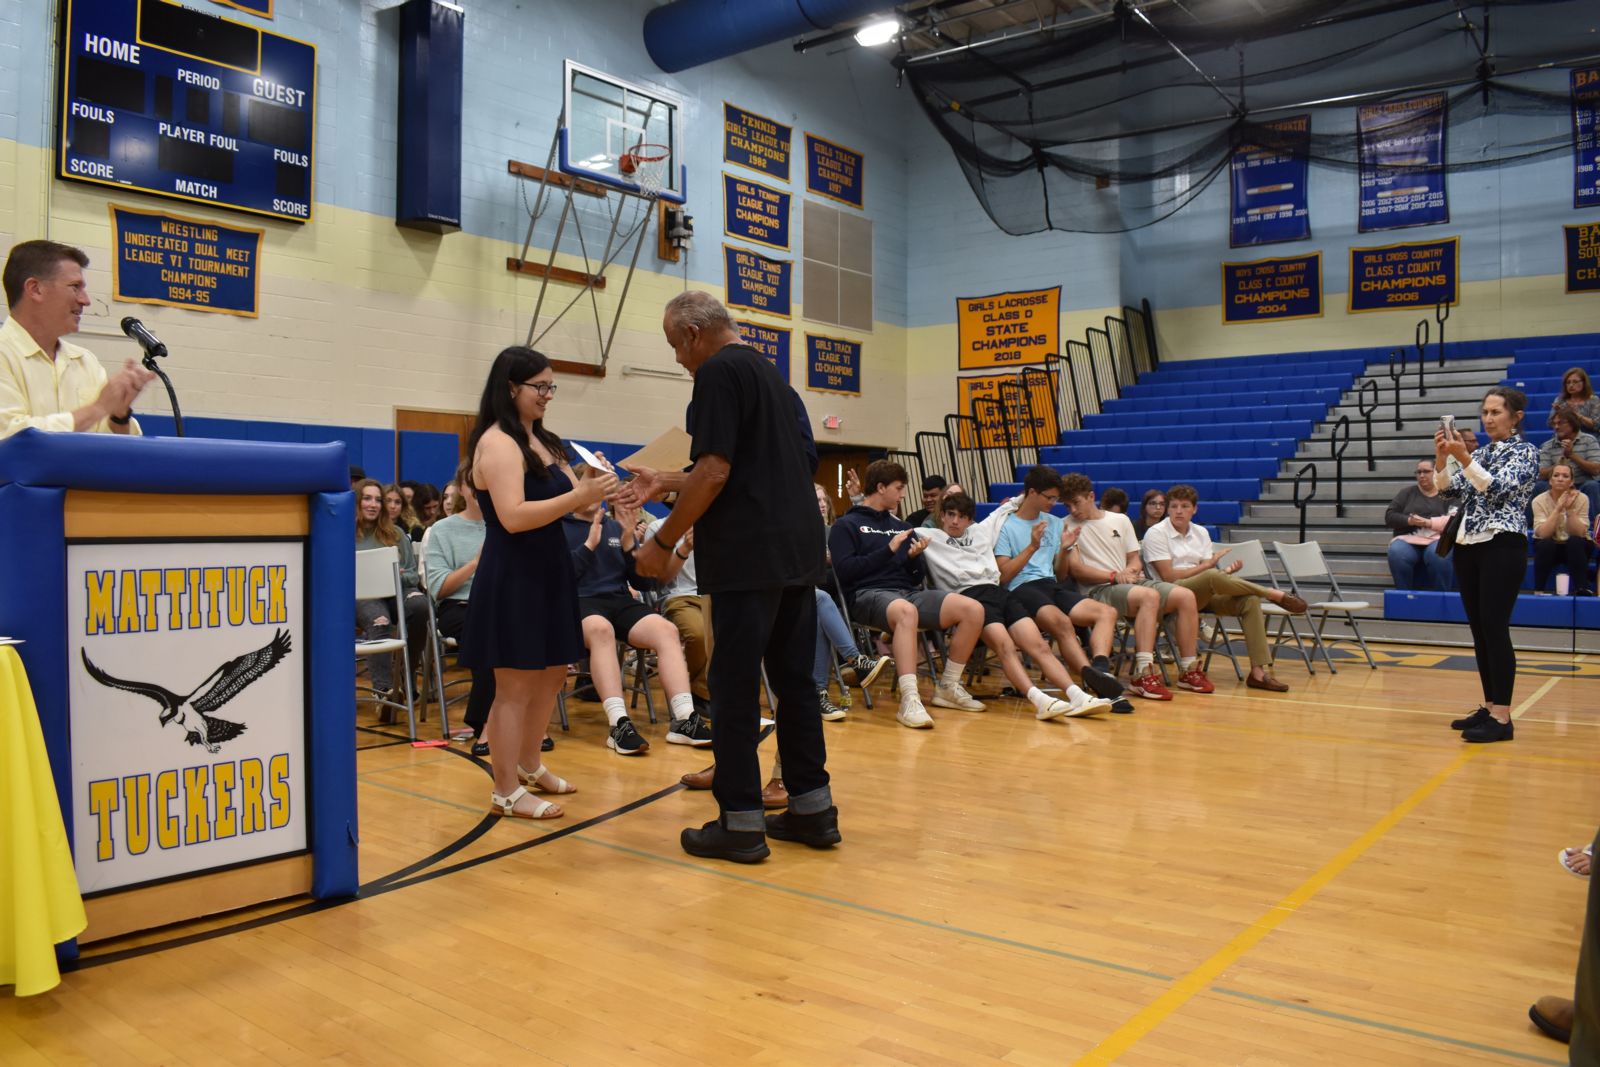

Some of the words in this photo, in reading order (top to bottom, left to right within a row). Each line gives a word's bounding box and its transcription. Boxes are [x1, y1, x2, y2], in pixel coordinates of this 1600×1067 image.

[85, 33, 140, 64] HOME
[177, 68, 220, 90] PERIOD
[253, 78, 305, 107] GUEST
[72, 102, 115, 124] FOULS
[741, 114, 776, 135] TENNIS
[159, 122, 205, 144] PLAYER
[210, 134, 239, 152] FOUL
[726, 121, 747, 137] GIRLS
[751, 130, 778, 148] LEAGUE
[273, 148, 308, 167] FOULS
[730, 136, 785, 163] CHAMPIONS
[814, 142, 832, 157] GIRLS
[836, 150, 856, 167] TRACK
[70, 158, 114, 178] SCORE
[748, 154, 767, 168] 1982
[817, 155, 842, 172] LEAGUE
[818, 167, 852, 187] CHAMPIONS
[175, 179, 217, 198] MATCH
[736, 183, 755, 195] GIRLS
[758, 189, 780, 203] TENNIS
[273, 198, 308, 216] SCORE
[738, 195, 763, 211] LEAGUE
[766, 203, 778, 216] VIII
[735, 208, 780, 229] CHAMPIONS
[161, 220, 218, 242] WRESTLING
[748, 225, 768, 237] 2001
[124, 231, 188, 253] UNDEFEATED
[194, 242, 219, 258] DUAL
[226, 248, 250, 262] MEET
[1363, 254, 1383, 264] GIRLS
[1386, 251, 1408, 262] CROSS
[1411, 248, 1444, 260] COUNTRY
[125, 248, 164, 265] LEAGUE
[170, 254, 182, 268] VI
[188, 257, 249, 278] TOURNAMENT
[736, 253, 755, 267] GIRLS
[759, 259, 781, 274] TENNIS
[1256, 265, 1275, 275] CROSS
[1279, 262, 1307, 272] COUNTRY
[1365, 264, 1394, 278] CLASS
[1398, 264, 1404, 275] C
[1407, 260, 1441, 273] COUNTY
[161, 269, 217, 289] CHAMPIONS
[738, 266, 763, 281] LEAGUE
[767, 273, 779, 286] VIII
[1239, 279, 1263, 291] CLASS
[1266, 278, 1272, 288] C
[1275, 274, 1305, 287] COUNTY
[1361, 274, 1446, 292] CHAMPIONS
[168, 286, 210, 303] 1994-95
[741, 279, 777, 297] CHAMPIONS
[1234, 288, 1310, 305] CHAMPIONS
[752, 293, 768, 306] 1993
[968, 301, 994, 312] GIRLS
[998, 295, 1048, 309] LACROSSE
[1257, 304, 1287, 314] 2004
[983, 311, 1019, 323] CLASS
[758, 330, 779, 342] TRACK
[986, 322, 1029, 336] STATE
[815, 339, 832, 351] GIRLS
[834, 343, 852, 354] TRACK
[972, 334, 1047, 352] CHAMPIONS
[818, 351, 840, 363] LEAGUE
[815, 363, 853, 377] CO-CHAMPIONS
[85, 564, 287, 636] MATTITUCK
[88, 753, 291, 863] TUCKERS
